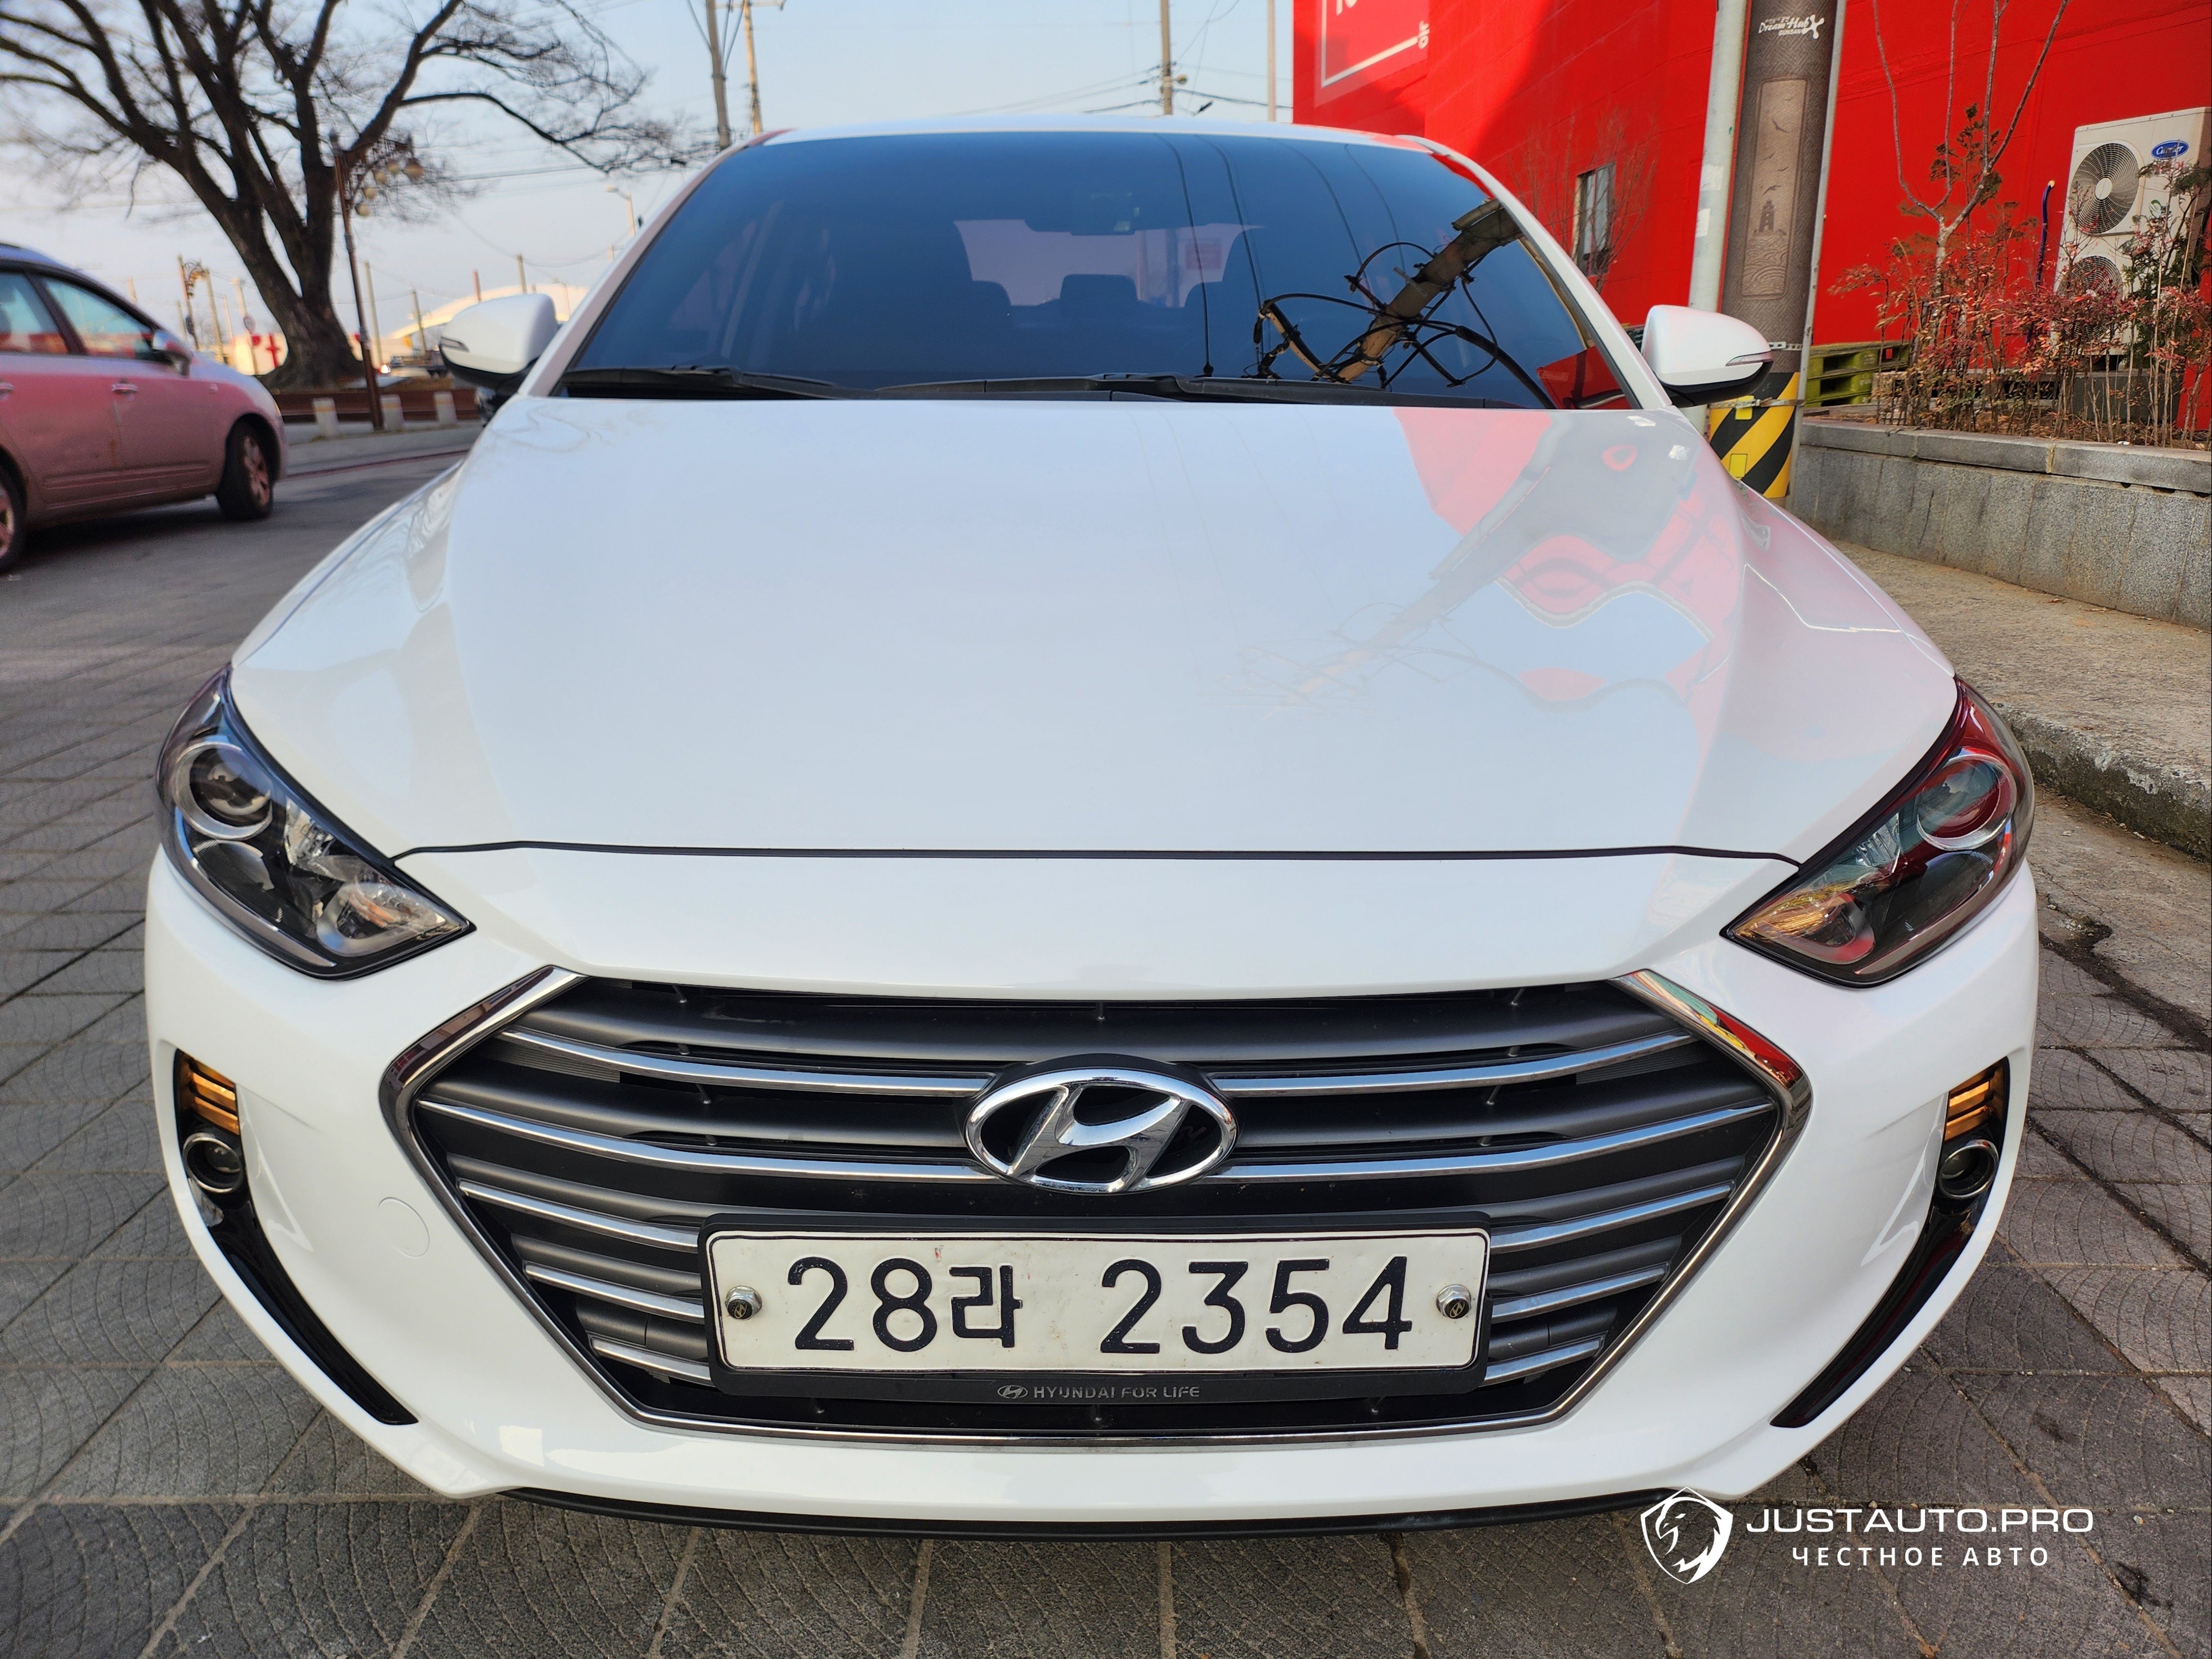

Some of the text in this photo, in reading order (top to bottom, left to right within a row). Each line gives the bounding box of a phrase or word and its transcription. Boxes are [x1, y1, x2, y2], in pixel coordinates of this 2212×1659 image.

[1759, 22, 1786, 34] Dream
[786, 1255, 1412, 1354] 28라 2354
[1034, 1386, 1200, 1399] HYUNDAI FOR LIFE
